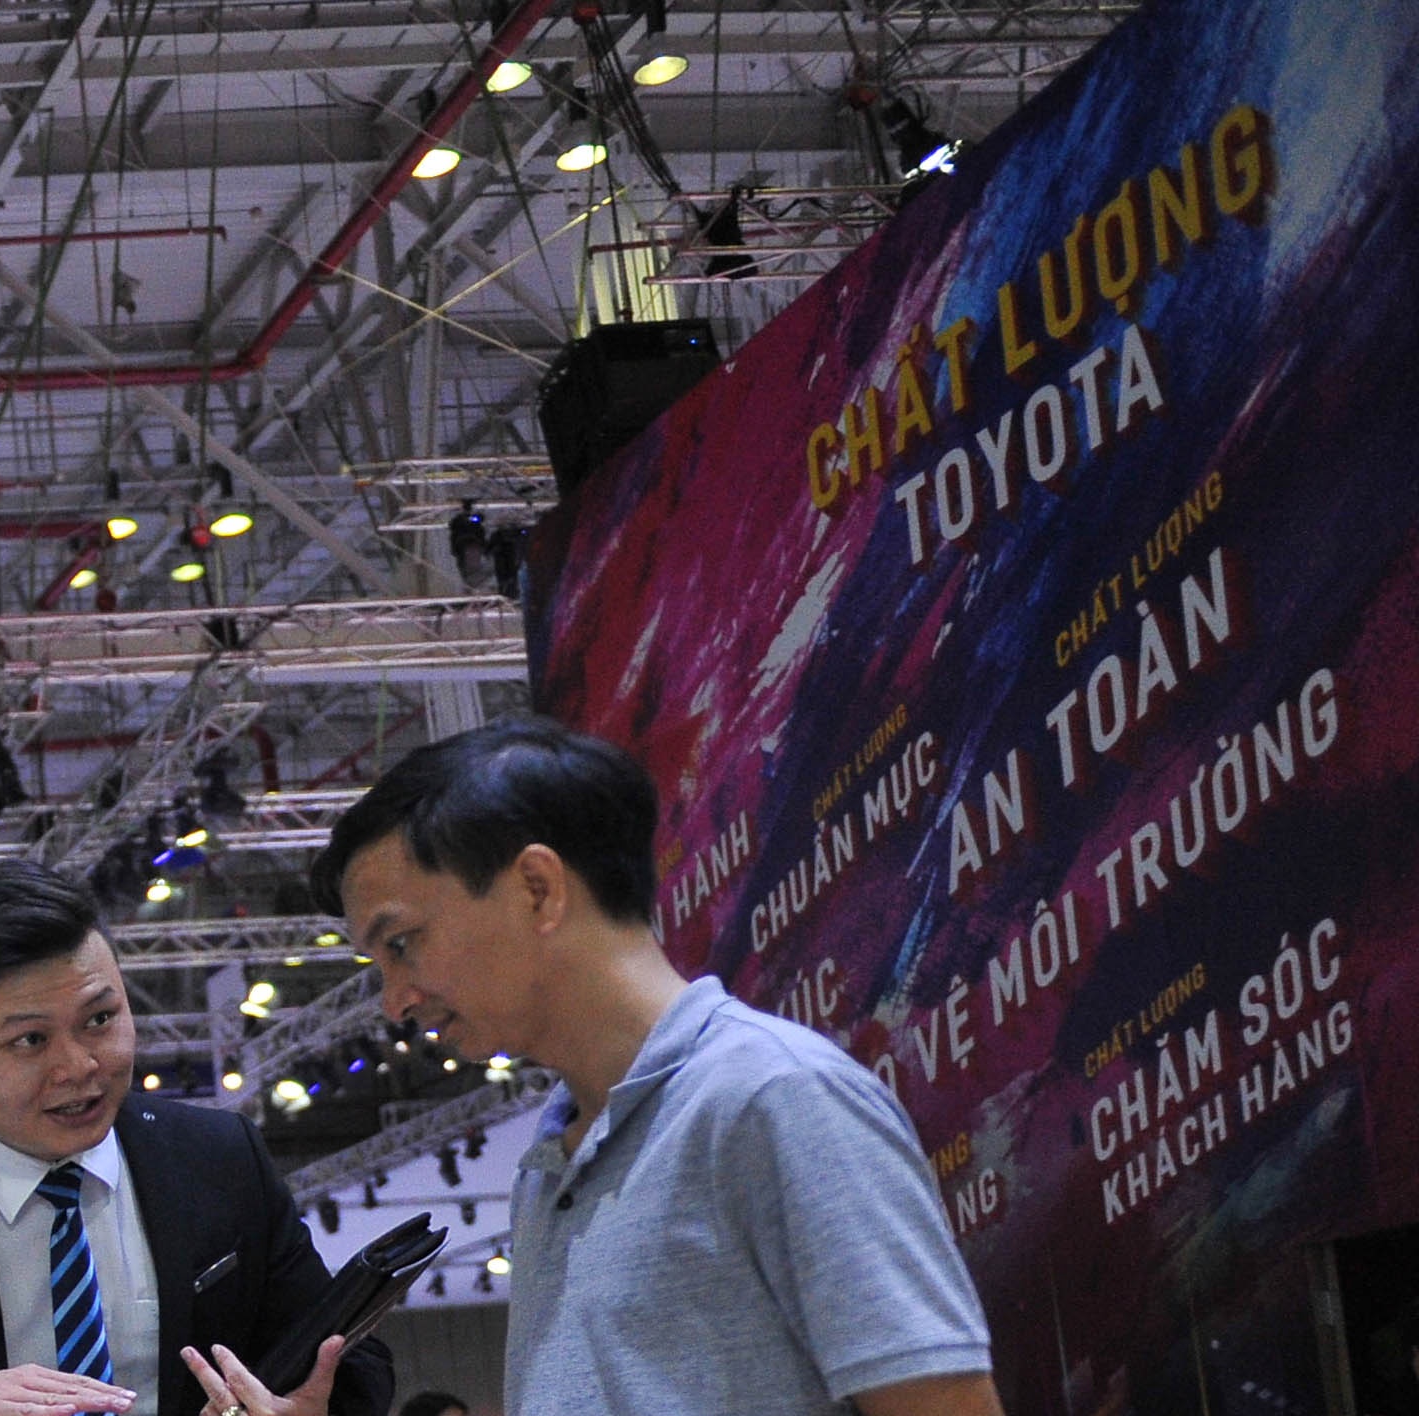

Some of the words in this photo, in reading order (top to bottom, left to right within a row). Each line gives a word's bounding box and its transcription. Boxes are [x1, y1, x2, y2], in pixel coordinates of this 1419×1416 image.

[806, 315, 972, 509] CHẤT
[997, 105, 1263, 375] LƯỢNG
[895, 323, 1164, 565] TOYOTA
[1131, 471, 1225, 590] LƯỢNG
[948, 748, 1025, 896] AN
[1045, 546, 1231, 788] TOÀN
[672, 810, 750, 928] HÀNH
[751, 813, 854, 952] CHUẨN
[863, 731, 936, 842] MỰC
[913, 974, 976, 1083] VỆ
[988, 889, 1080, 1027] MÔI
[1095, 668, 1339, 930] TRƯỜNG
[777, 957, 837, 1030] ÚC
[1090, 1009, 1223, 1162] CHĂM
[1239, 917, 1340, 1047] SÓC
[1102, 1093, 1228, 1225] KHÁCH
[1238, 1000, 1353, 1123] HÀNG
